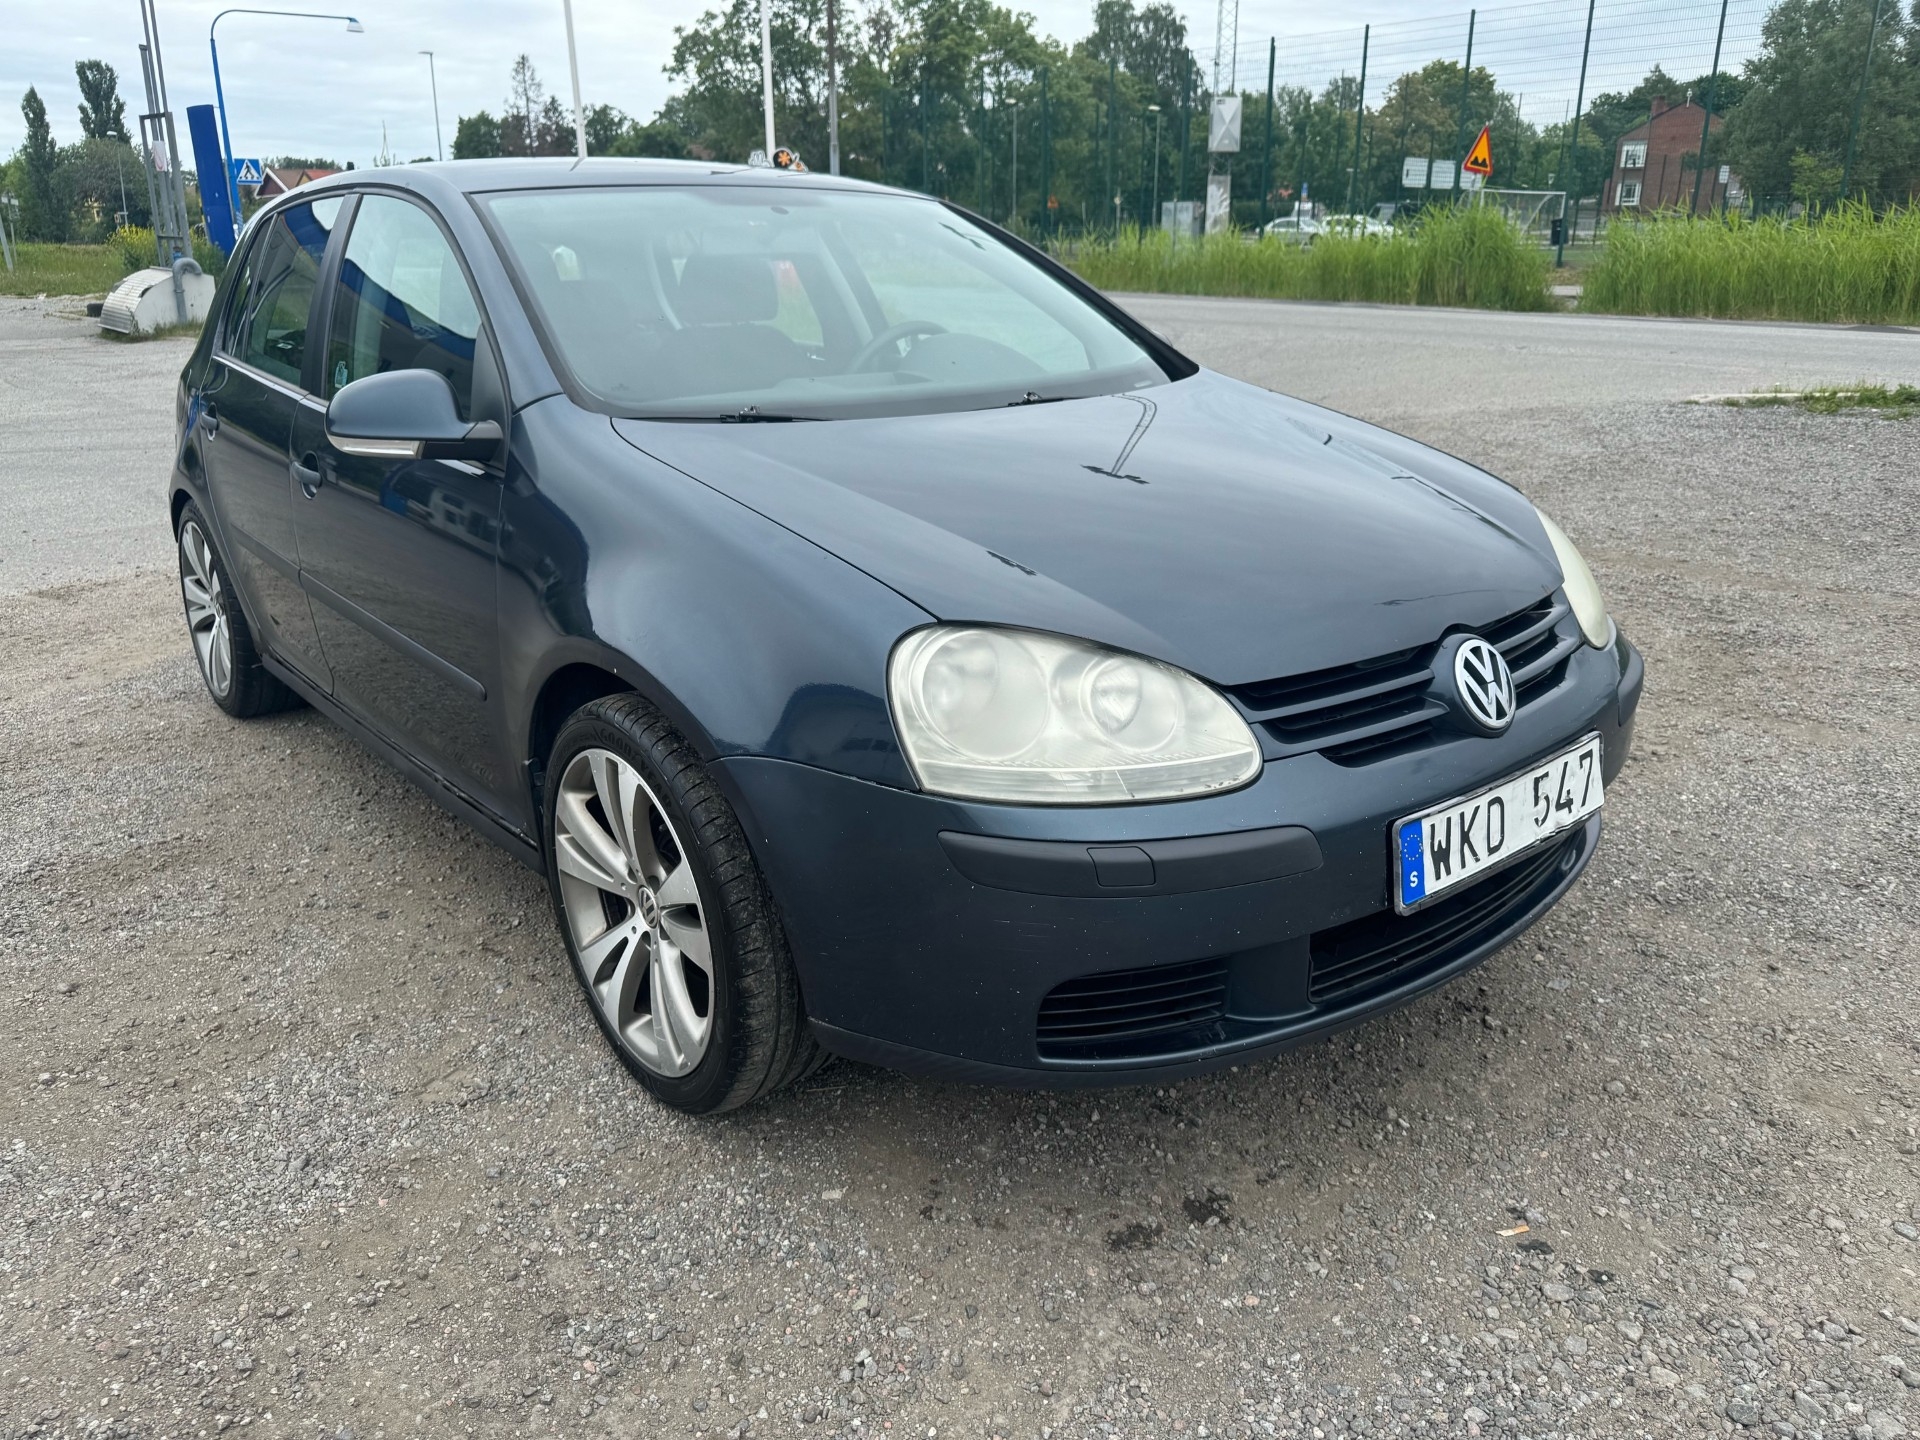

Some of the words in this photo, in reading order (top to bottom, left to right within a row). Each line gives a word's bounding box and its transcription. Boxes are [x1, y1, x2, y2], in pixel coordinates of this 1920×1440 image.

[1456, 640, 1515, 727] VW
[1430, 796, 1505, 881] WKD
[1533, 749, 1593, 828] 547
[1409, 871, 1419, 888] S
